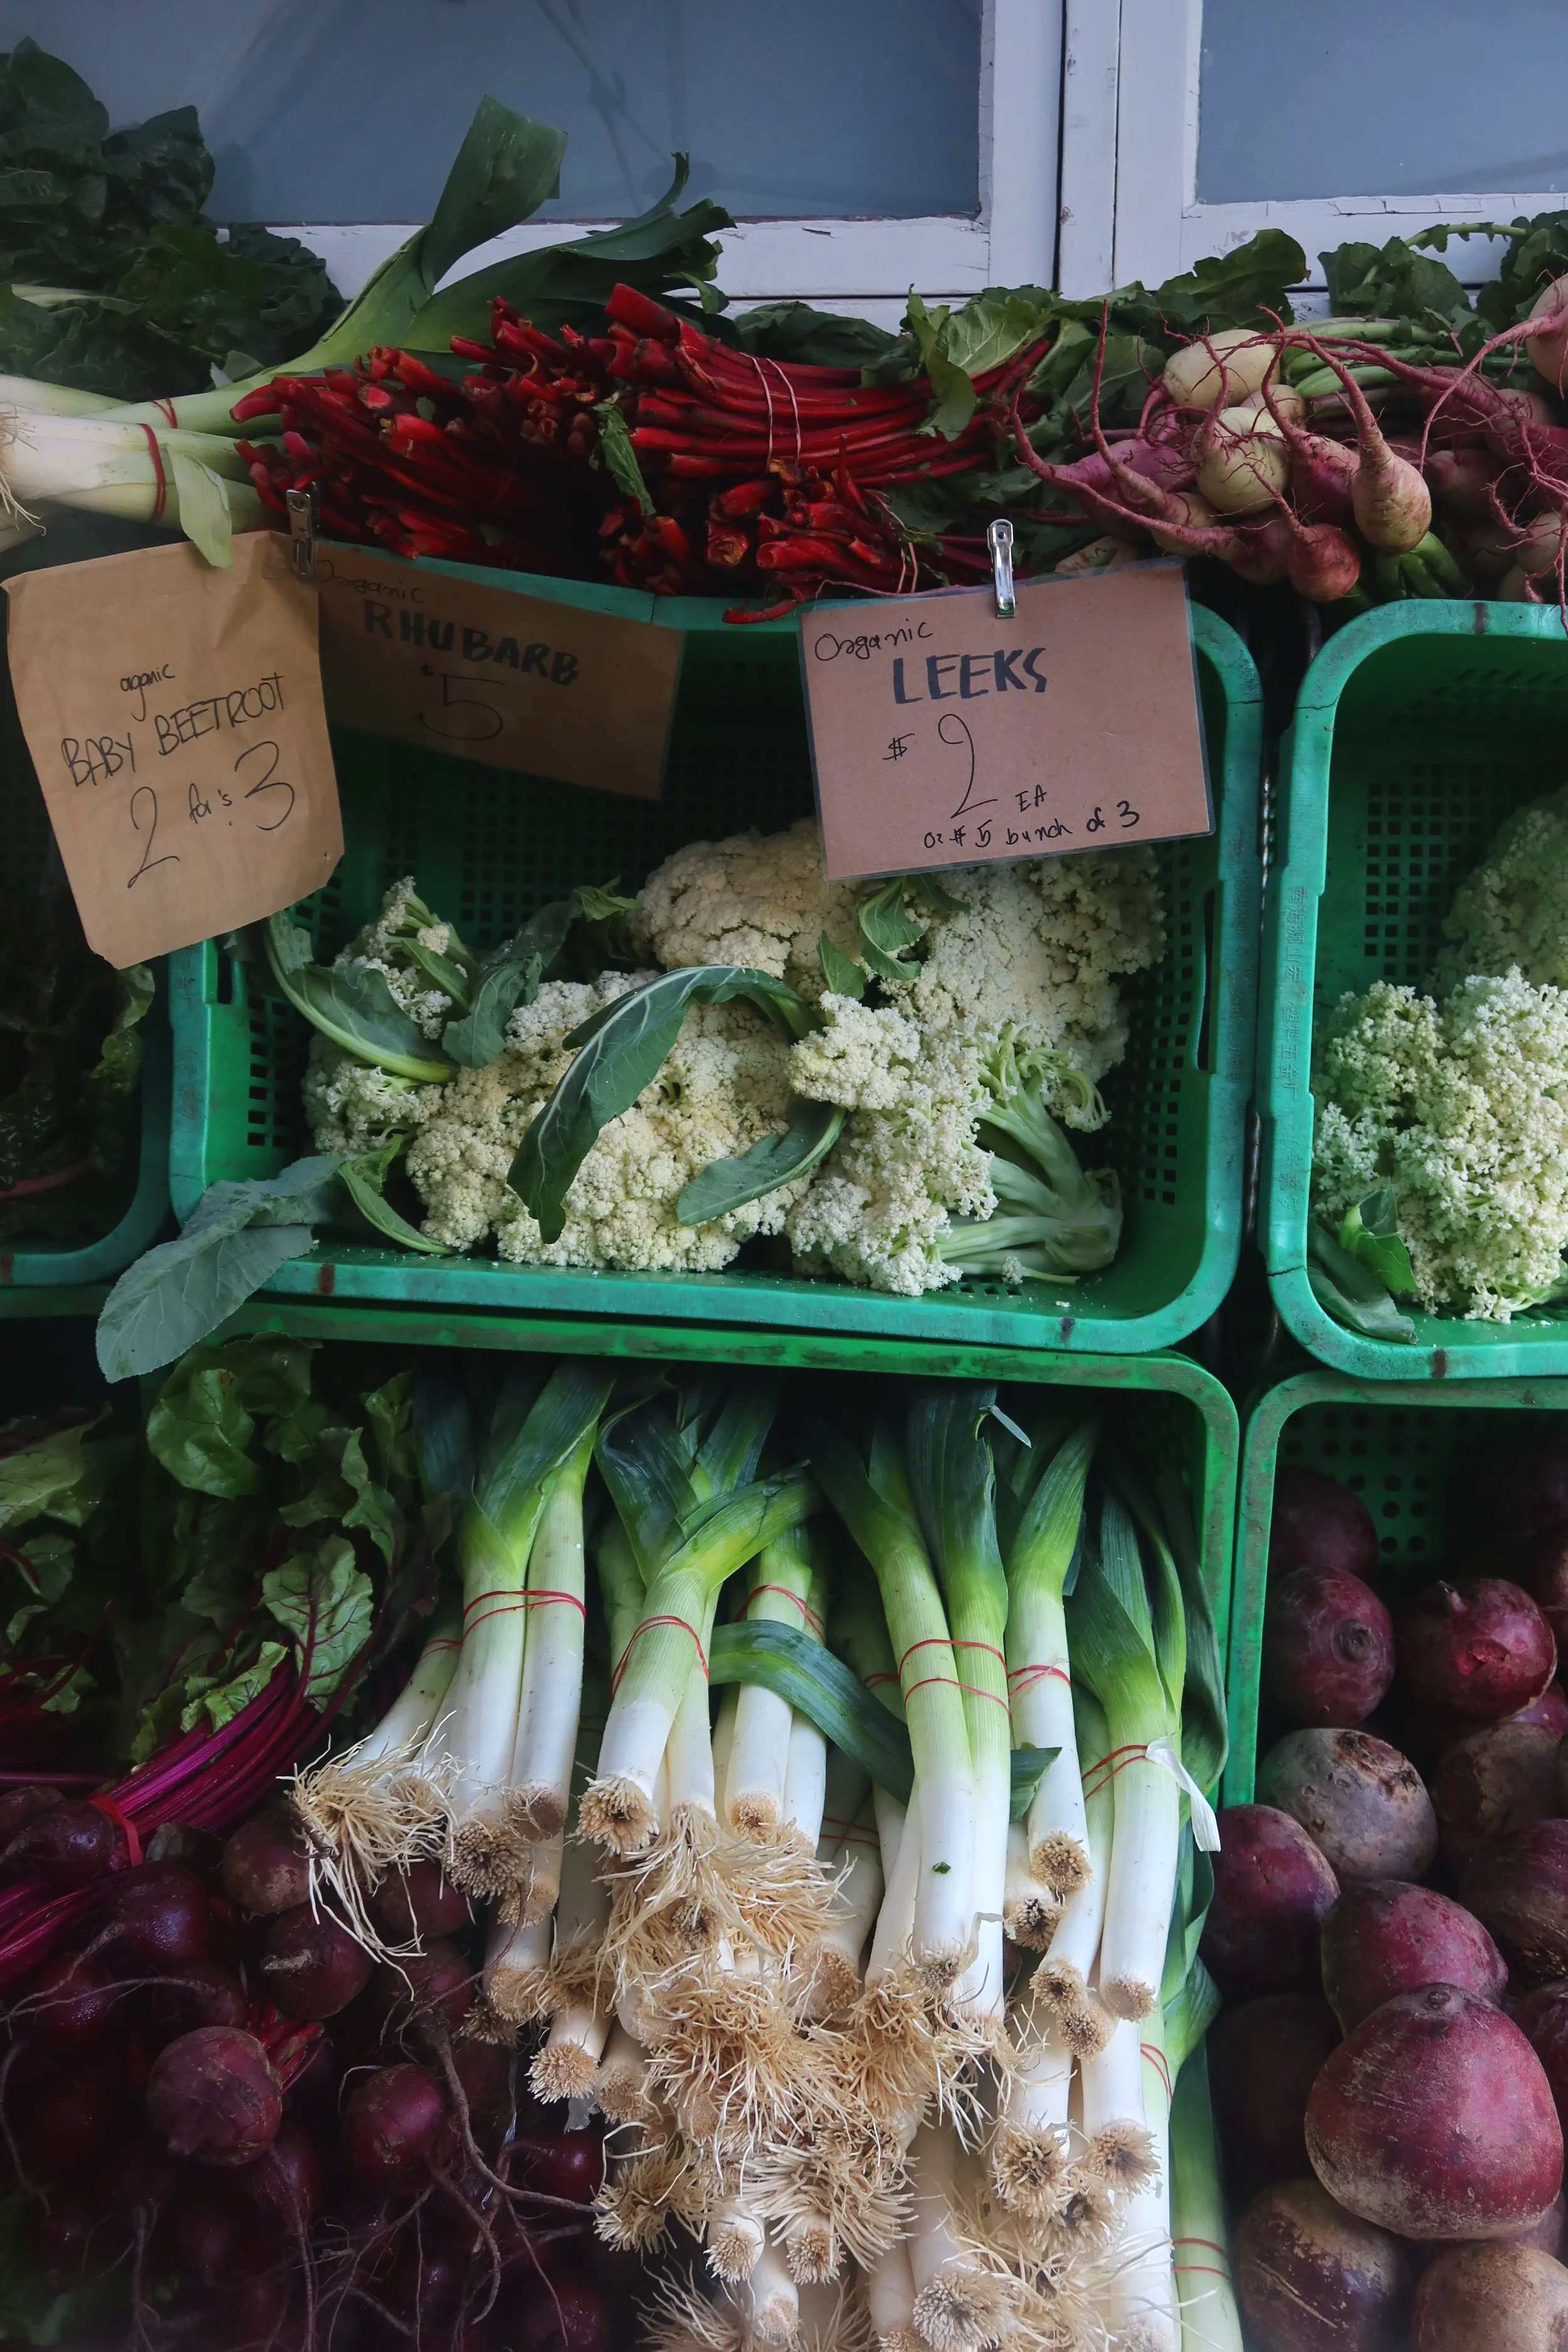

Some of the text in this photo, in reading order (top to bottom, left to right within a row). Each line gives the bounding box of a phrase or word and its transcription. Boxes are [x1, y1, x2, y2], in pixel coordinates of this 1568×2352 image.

[363, 600, 580, 686] RHUBARB
[815, 618, 934, 661] Organic
[892, 647, 1047, 706] LEEKS
[61, 672, 284, 787] BABY BEETROOT
[1005, 817, 1074, 845] bunch
[1086, 807, 1106, 833] of
[1116, 800, 1140, 829] 3
[1015, 784, 1047, 812] EA
[127, 786, 180, 888] 2
[188, 782, 212, 824] for
